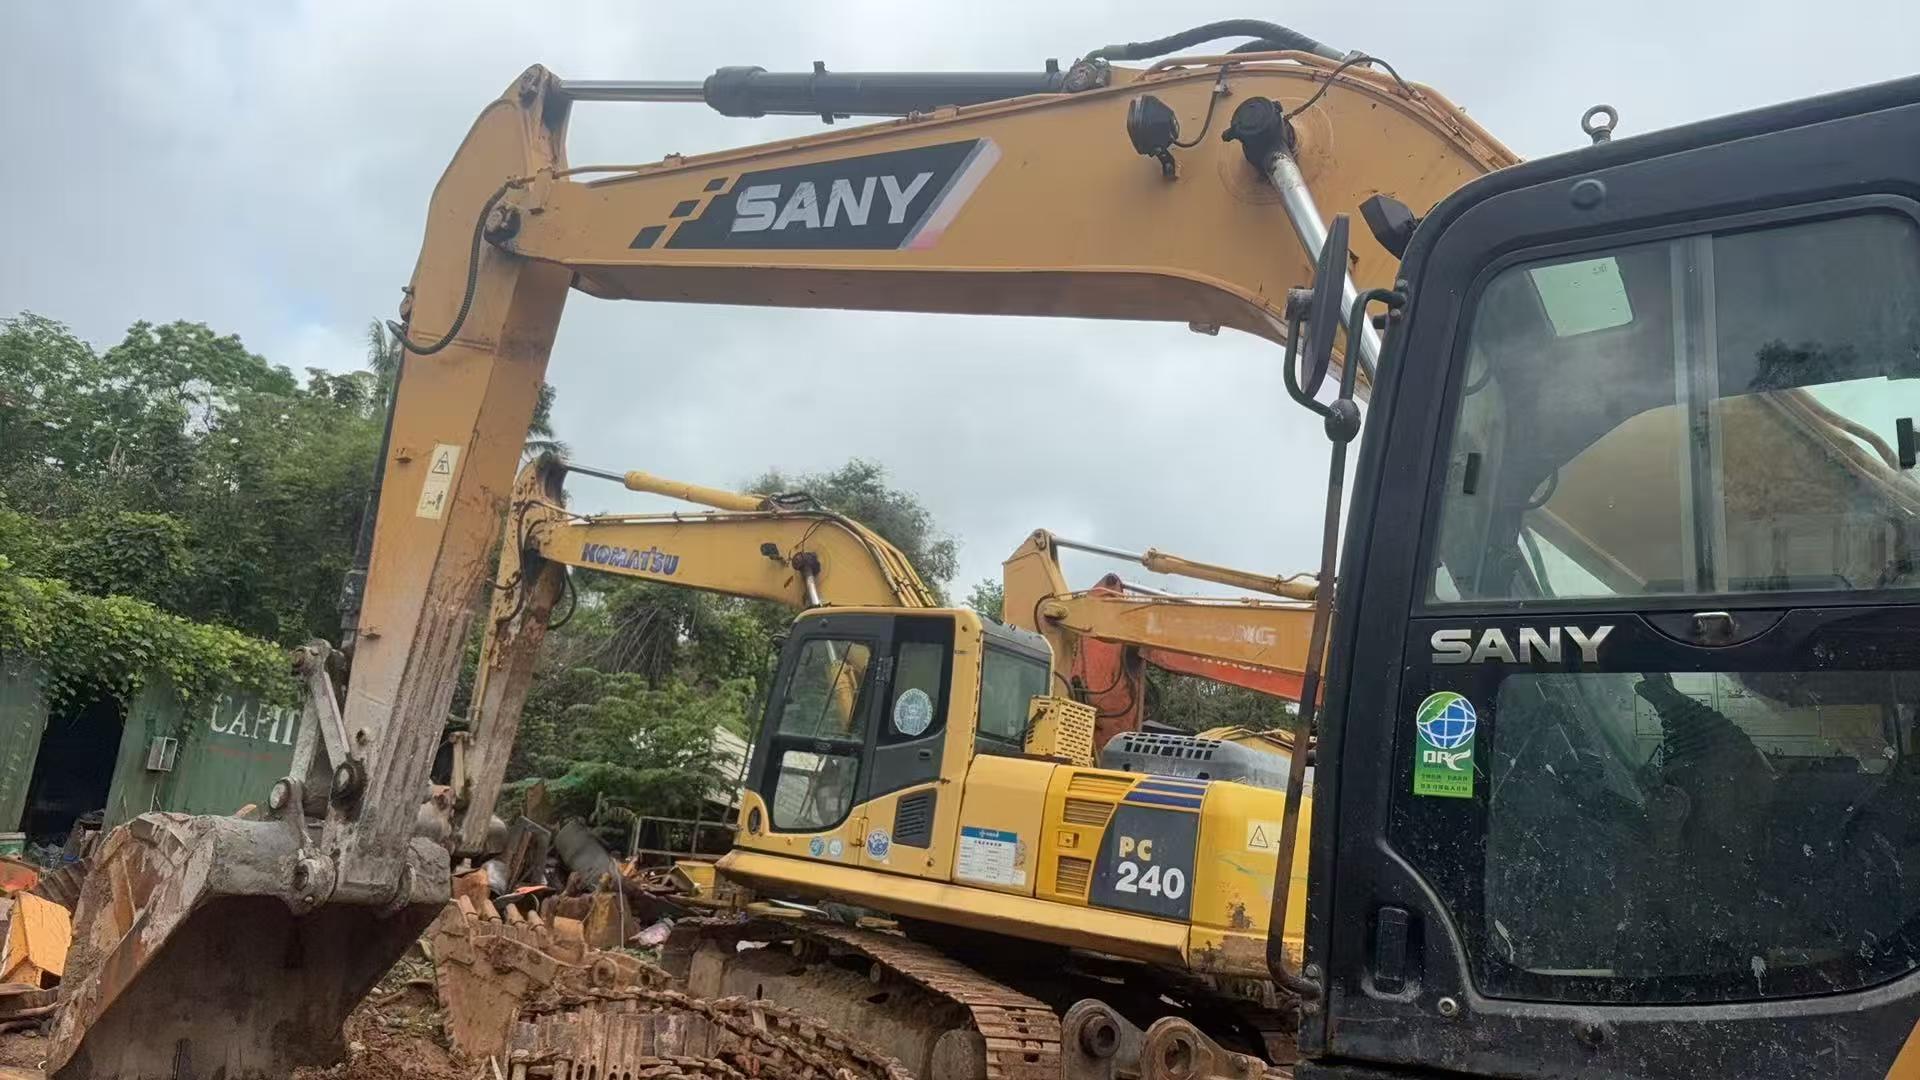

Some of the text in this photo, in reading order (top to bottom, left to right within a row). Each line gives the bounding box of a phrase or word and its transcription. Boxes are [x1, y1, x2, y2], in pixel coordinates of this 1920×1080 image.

[731, 172, 934, 232] SANY
[581, 543, 680, 575] KOMATSU
[1431, 625, 1615, 664] SANY
[1119, 836, 1153, 861] PC
[1115, 861, 1185, 899] 240
